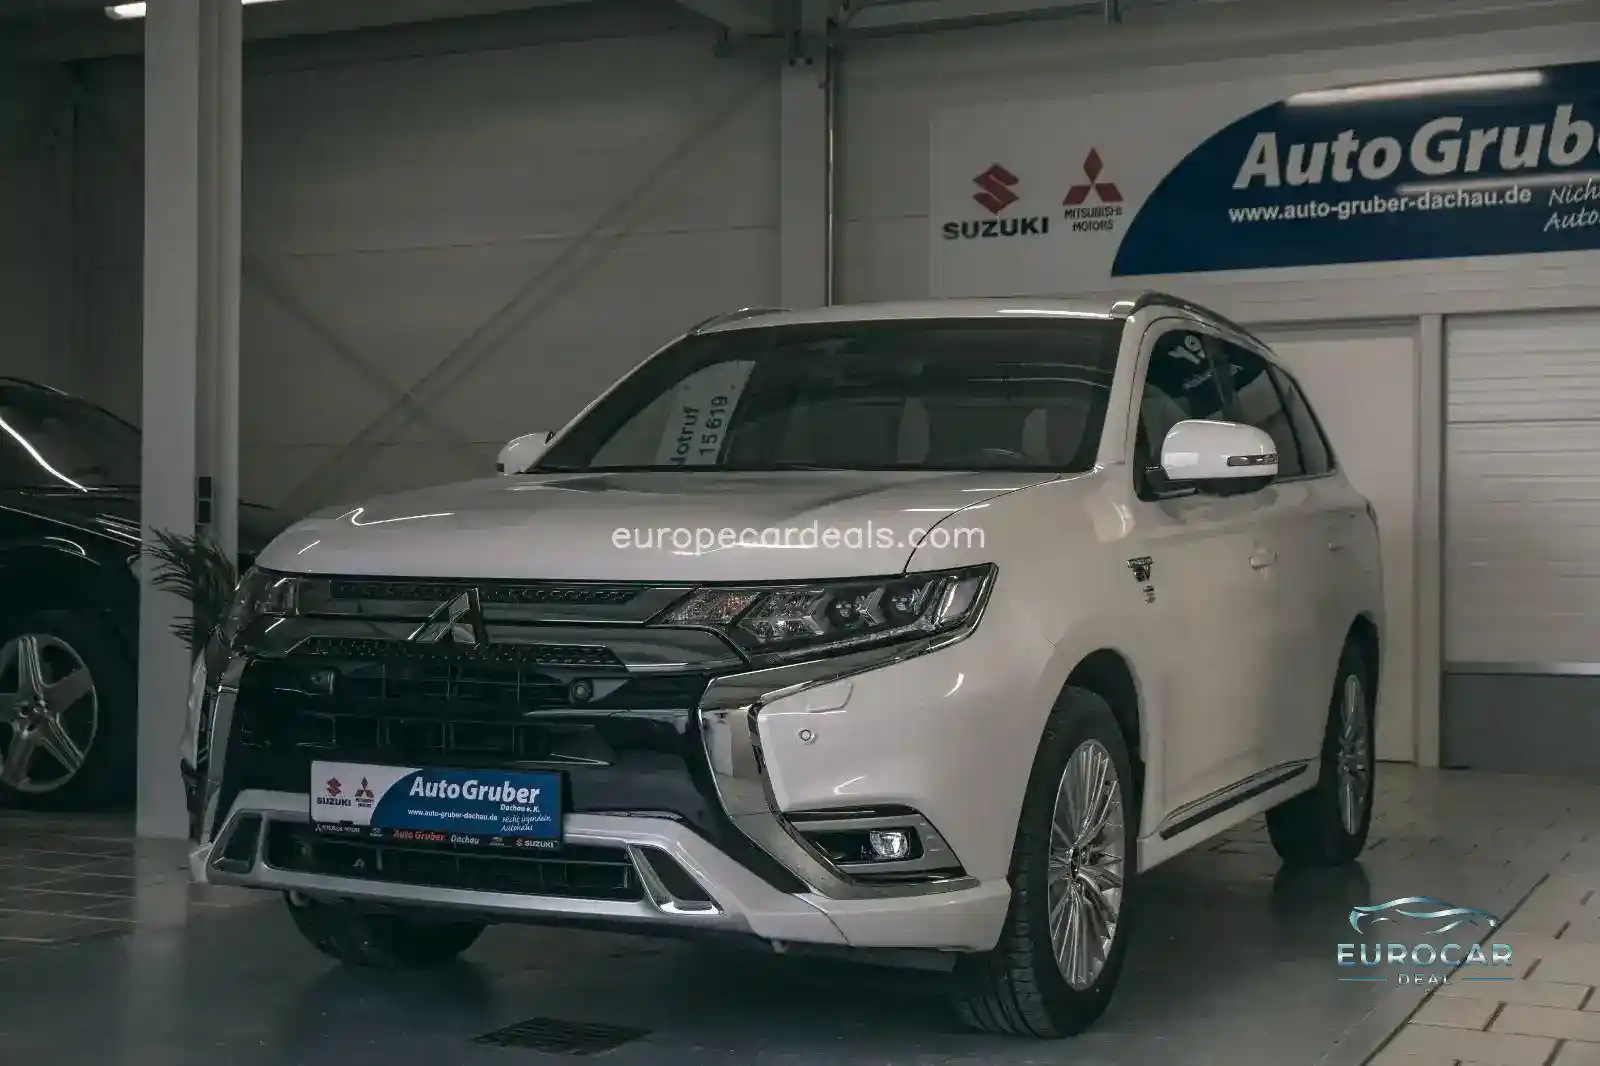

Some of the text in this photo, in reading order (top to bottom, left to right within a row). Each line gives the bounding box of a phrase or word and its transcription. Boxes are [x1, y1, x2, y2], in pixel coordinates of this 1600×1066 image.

[1548, 177, 1600, 207] Nich
[1229, 184, 1532, 223] www.auto-gruber-dachau.de
[1072, 219, 1114, 232] MOTORS
[1543, 206, 1600, 232] Auto
[943, 216, 1050, 240] SUZUKI
[316, 797, 351, 807] SUZUKI
[500, 803, 525, 812] Dachau
[450, 834, 480, 844] Dachau
[524, 840, 554, 848] SUZUKI
